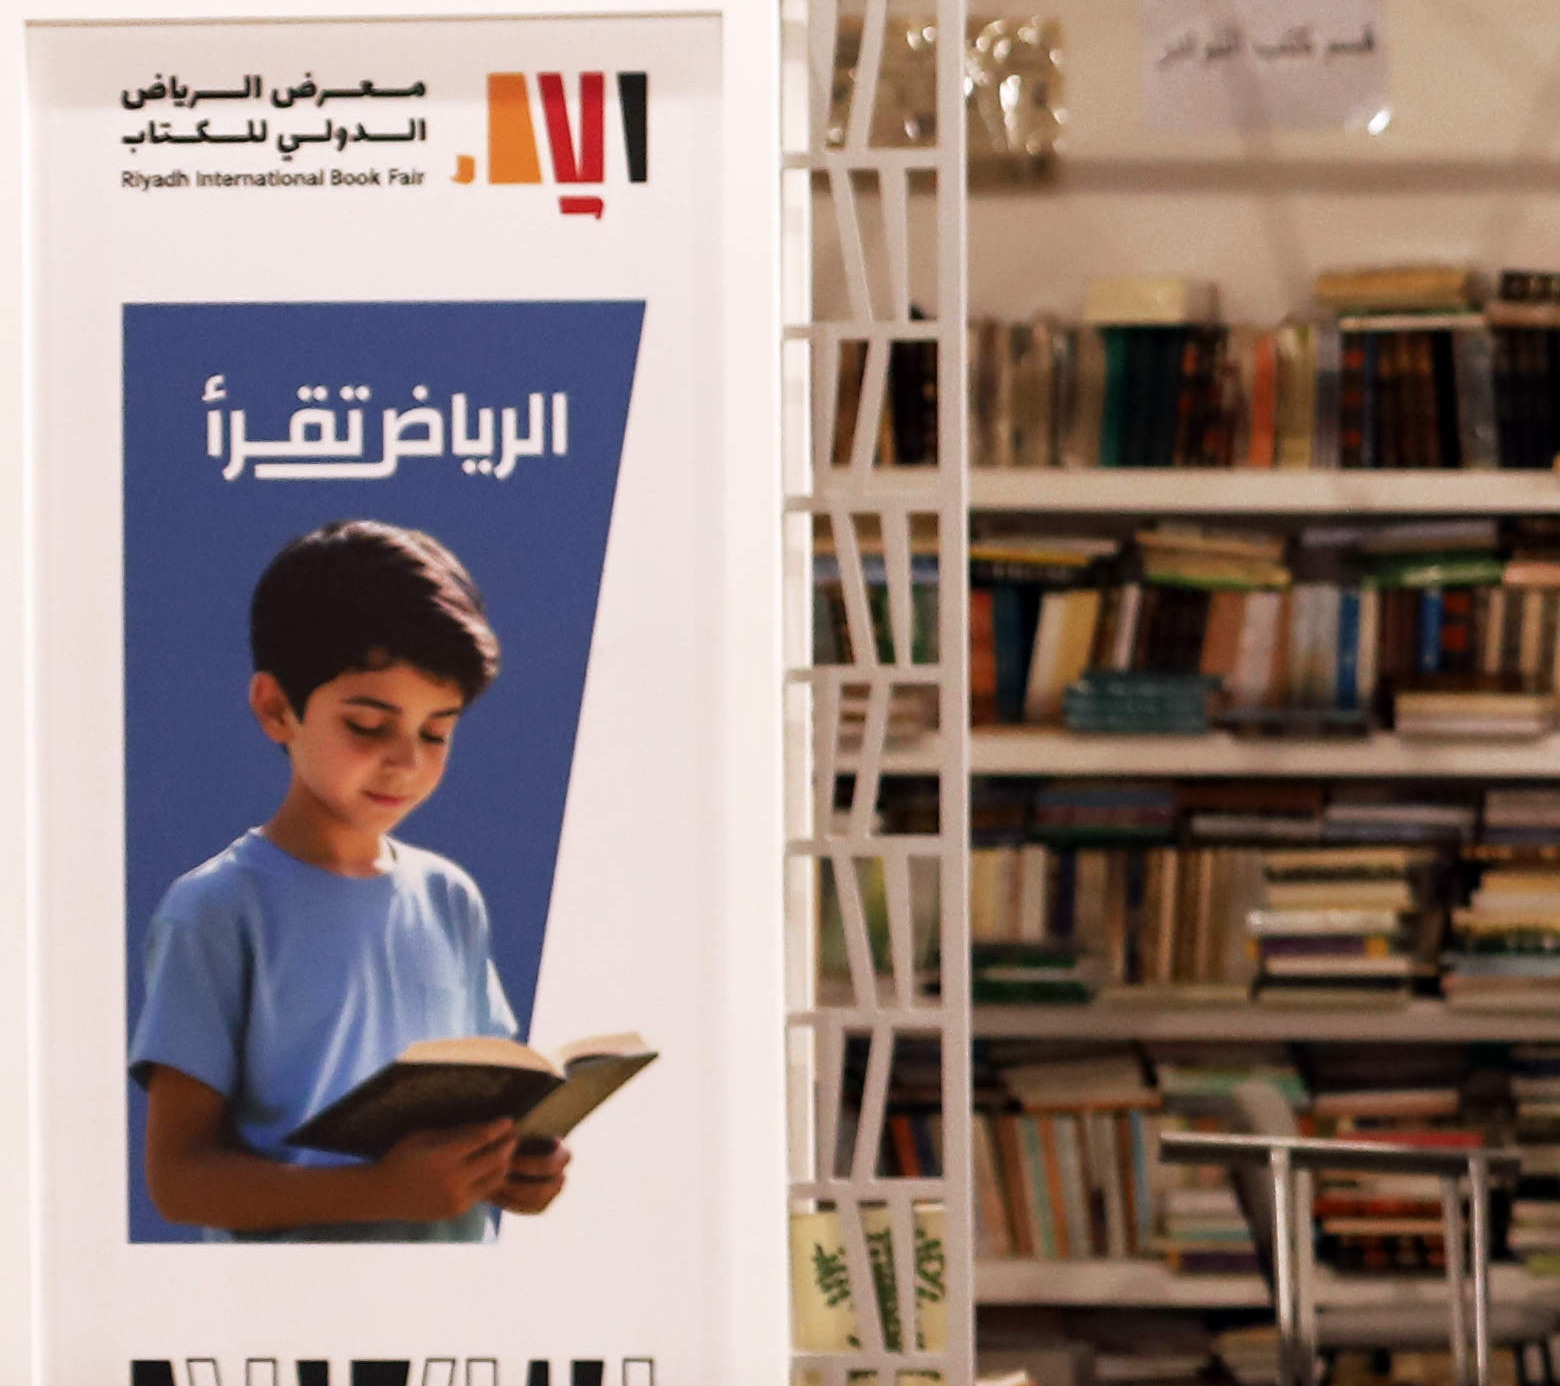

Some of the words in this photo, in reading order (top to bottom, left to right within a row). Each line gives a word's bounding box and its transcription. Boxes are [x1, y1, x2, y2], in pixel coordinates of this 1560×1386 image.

[121, 73, 263, 110] الرياض
[270, 72, 427, 109] معرض
[121, 119, 268, 153] للكتاب
[276, 118, 427, 161] الدولي
[122, 170, 190, 189] Riyadh
[196, 171, 324, 187] International
[330, 169, 381, 187] Book
[388, 168, 425, 186] Fair
[201, 374, 374, 481] تقرأ
[254, 385, 568, 480] الرياض
